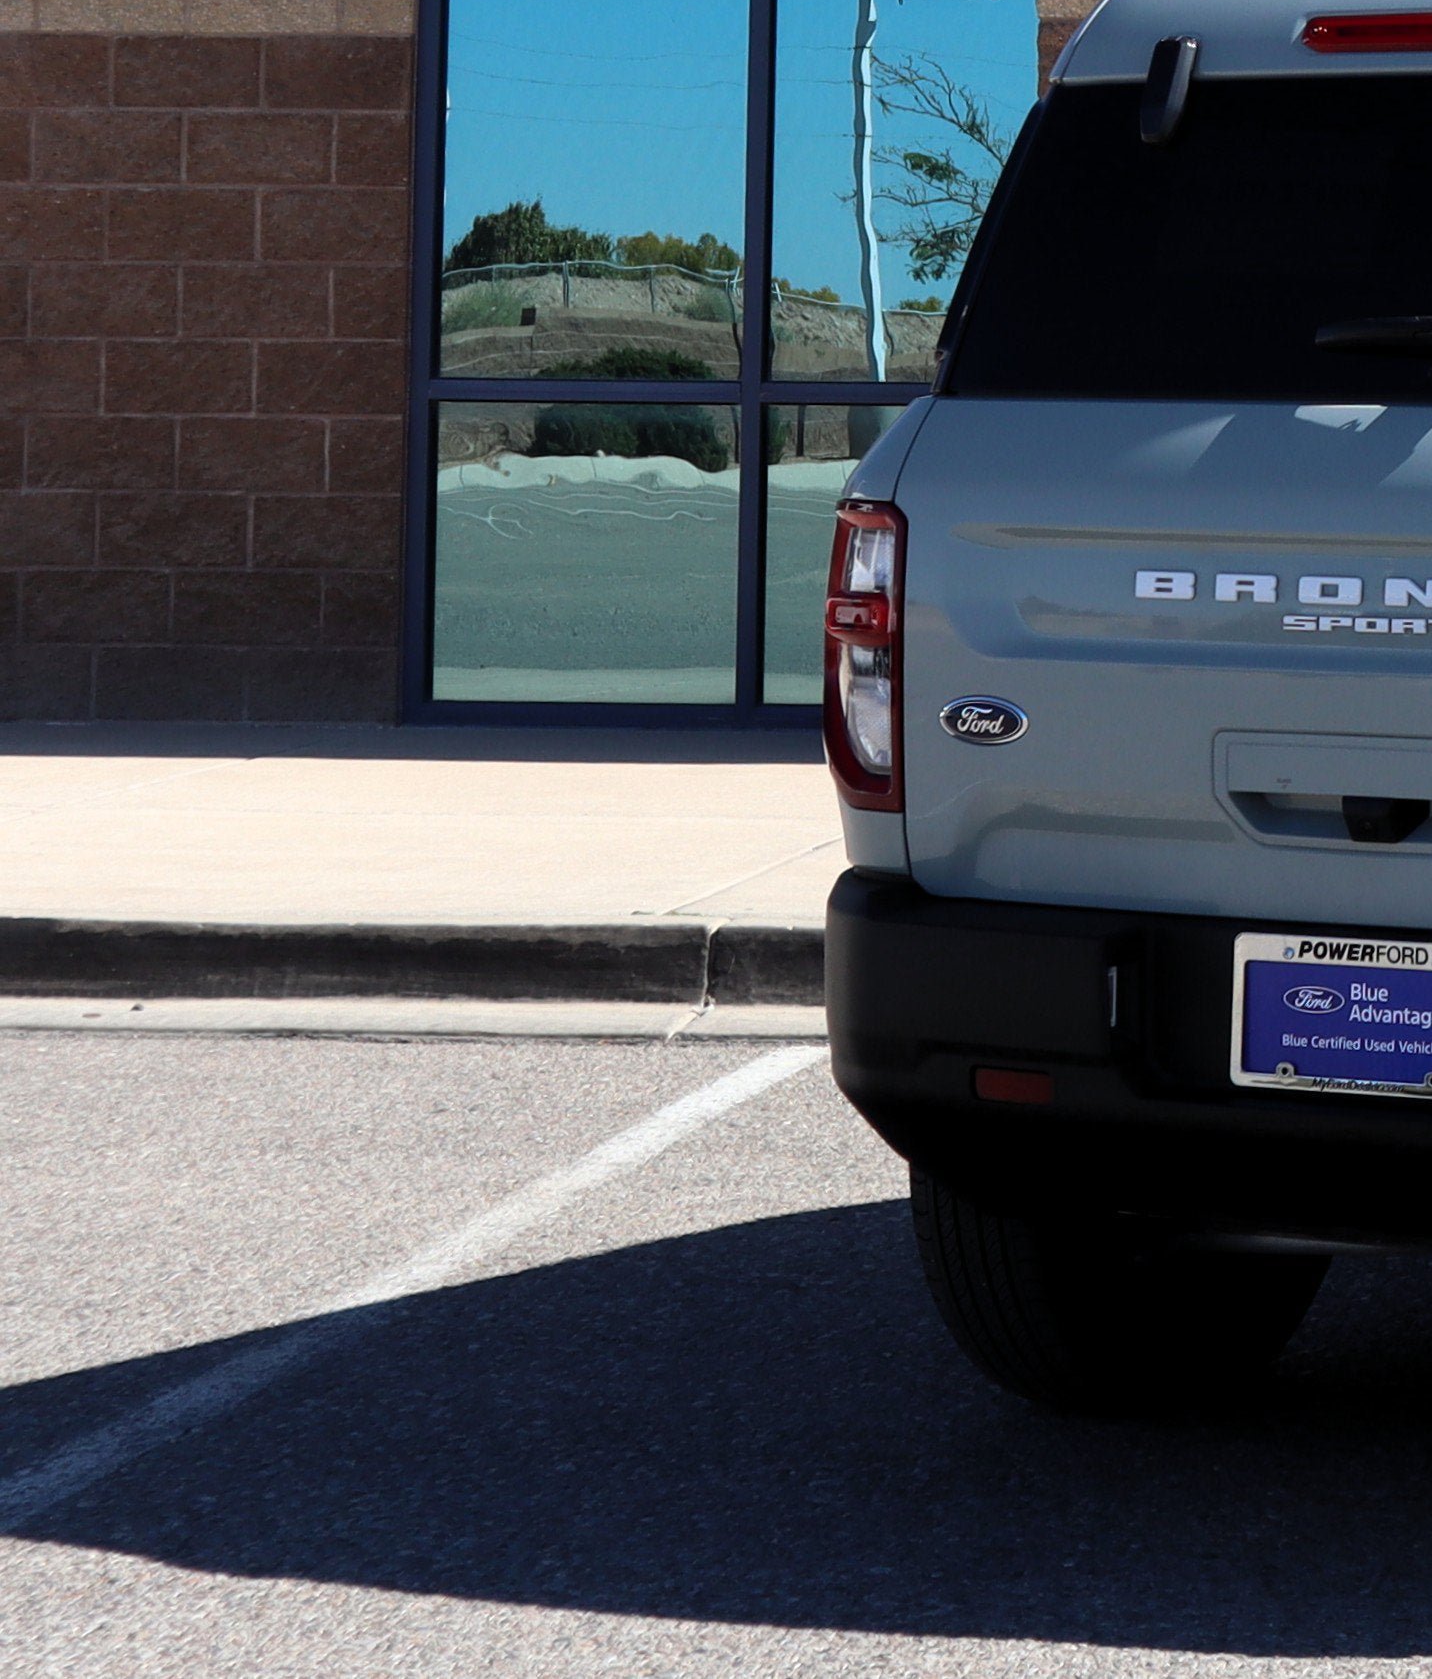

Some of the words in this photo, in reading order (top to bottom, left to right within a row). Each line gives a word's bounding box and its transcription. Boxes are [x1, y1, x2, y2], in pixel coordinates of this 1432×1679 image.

[956, 705, 1005, 734] Ford
[1298, 940, 1429, 965] POWERFORD
[1294, 989, 1333, 1009] Ford
[1350, 982, 1389, 1002] Blue
[1282, 1033, 1308, 1048] Blue
[1311, 1035, 1361, 1050] Certified
[1364, 1039, 1395, 1053] Used
